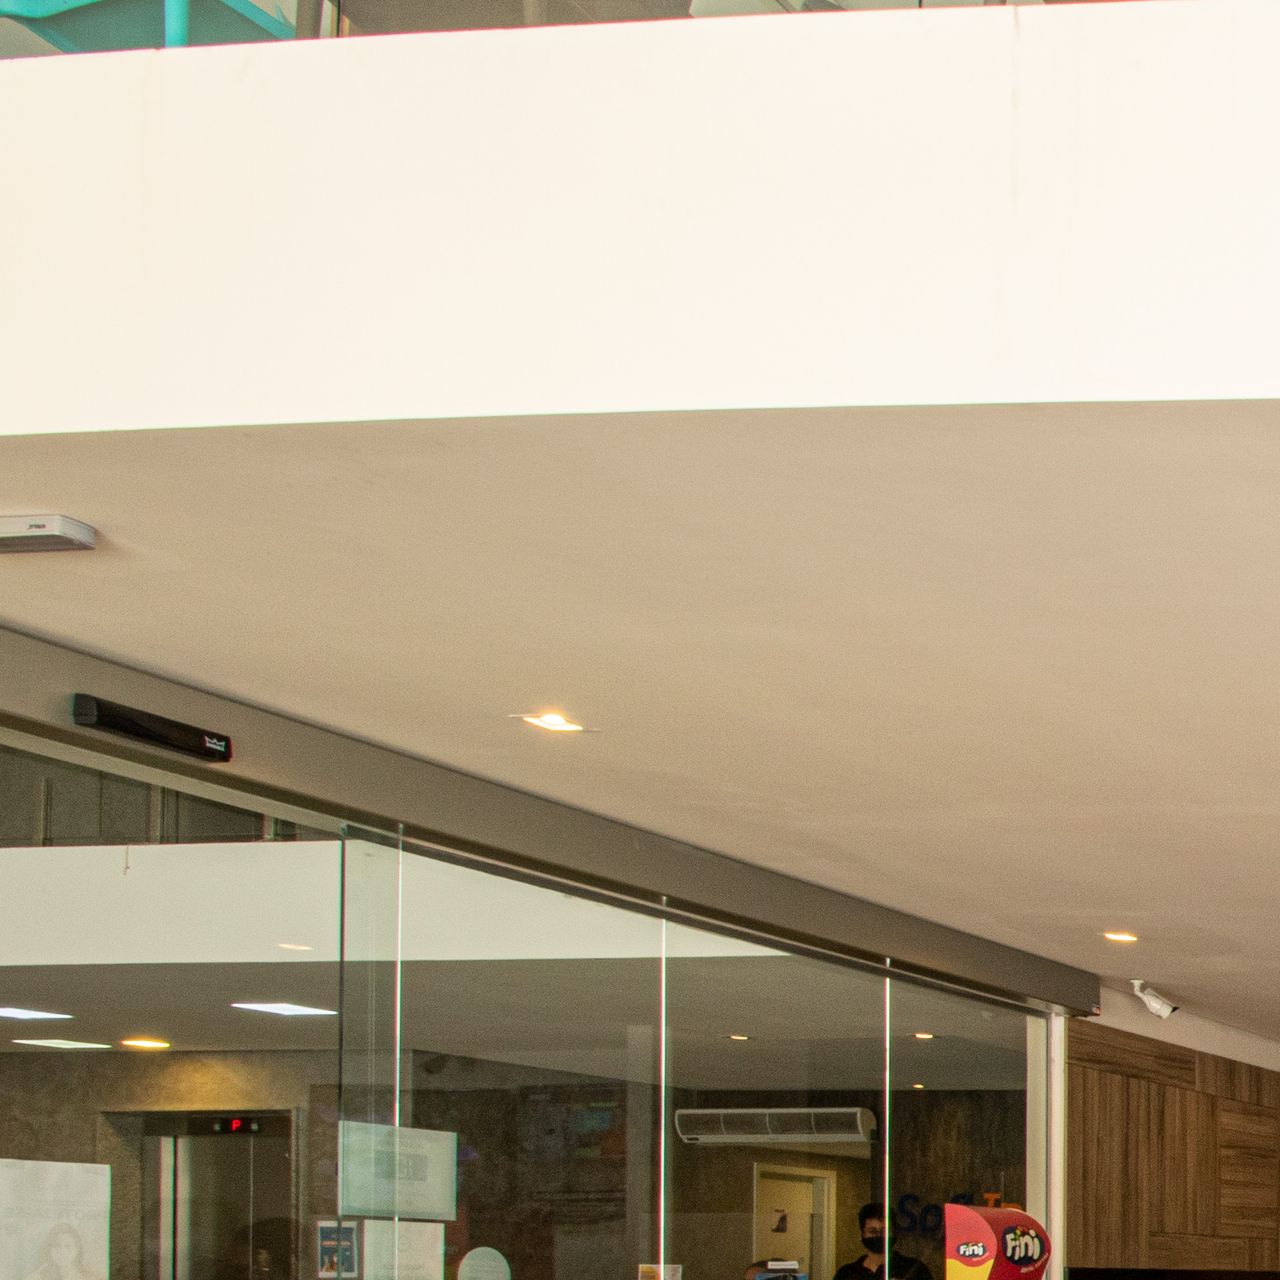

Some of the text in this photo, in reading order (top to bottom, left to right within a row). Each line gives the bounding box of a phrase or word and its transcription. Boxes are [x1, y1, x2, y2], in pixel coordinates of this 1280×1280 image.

[231, 1119, 242, 1131] P
[959, 1243, 984, 1257] Fini
[1004, 1229, 1041, 1261] Fini
